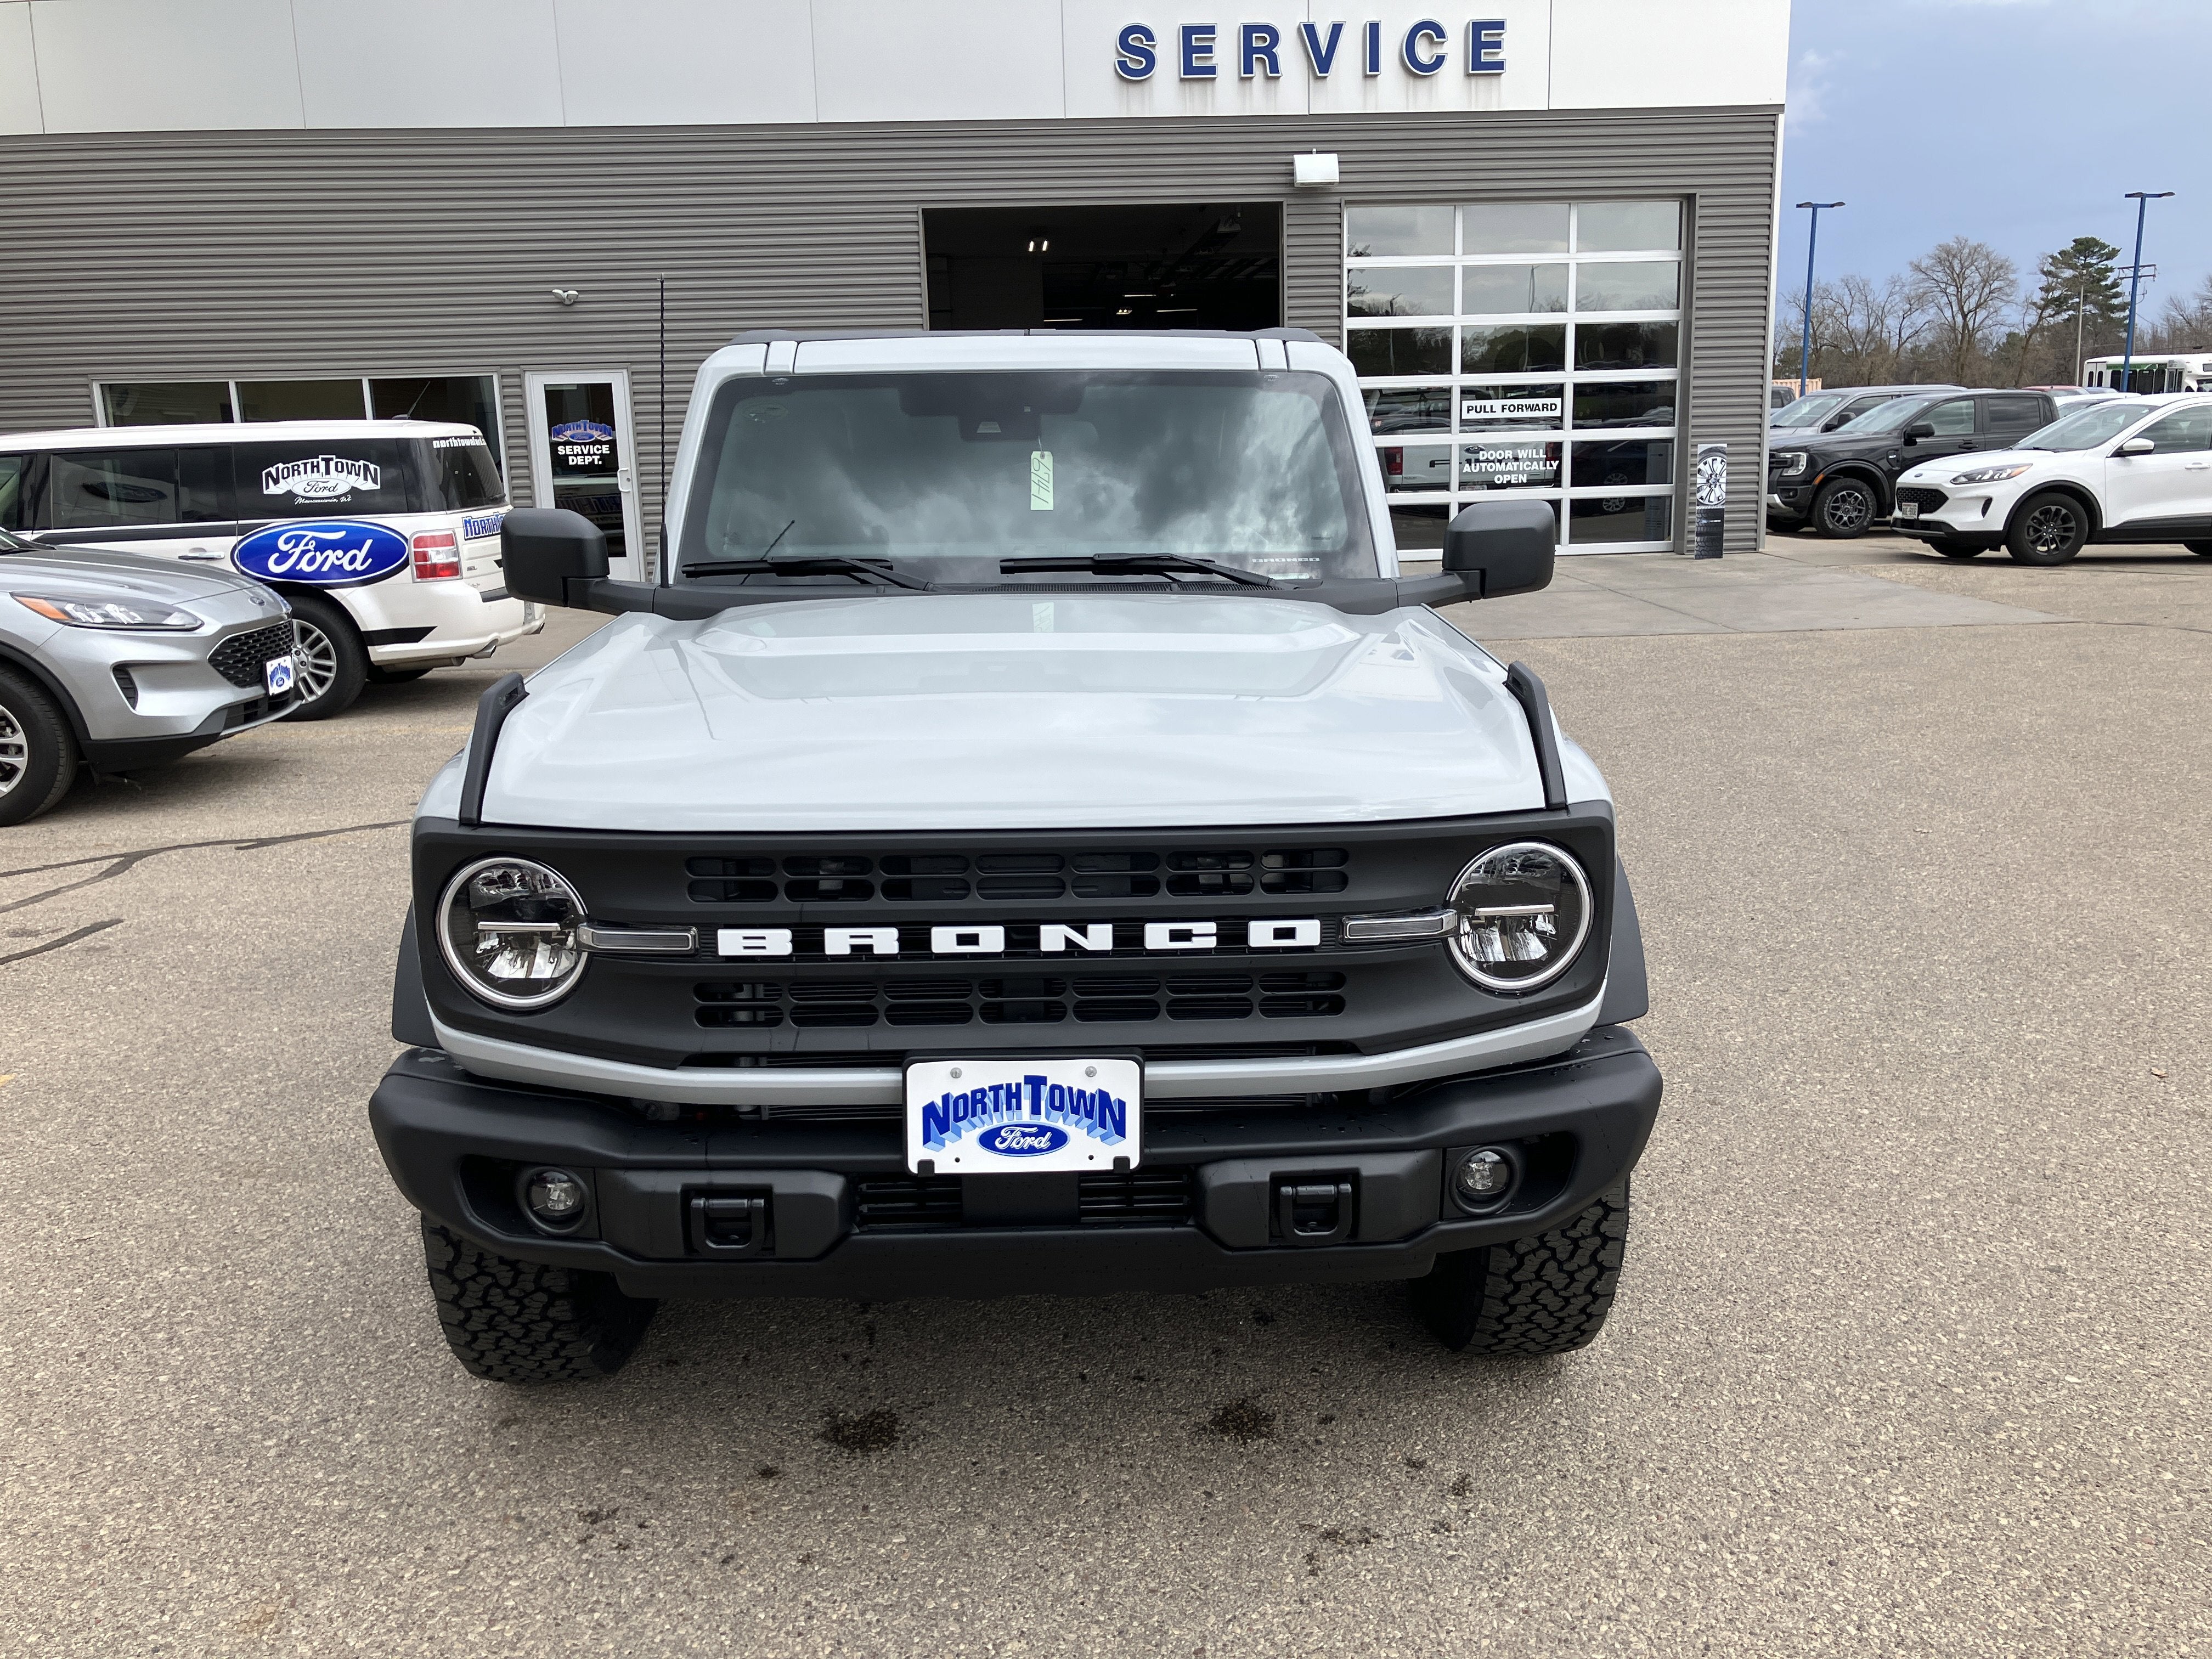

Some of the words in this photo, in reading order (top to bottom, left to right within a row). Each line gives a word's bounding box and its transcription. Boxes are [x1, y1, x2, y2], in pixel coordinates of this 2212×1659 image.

[1115, 18, 1508, 81] SERVICE
[1466, 404, 1497, 414] PULL
[1501, 403, 1558, 413] FORWARD
[557, 444, 610, 455] SERVICE
[1479, 450, 1513, 460] DOOR
[1517, 449, 1547, 459] WILL
[568, 455, 602, 466] DEPT.
[1462, 460, 1560, 473] AUTOMATICALLY
[1494, 473, 1527, 484] OPEN
[303, 480, 338, 493] Ford
[267, 531, 374, 573] Ford
[716, 919, 1321, 956] BRONCO
[994, 1126, 1053, 1150] Ford
